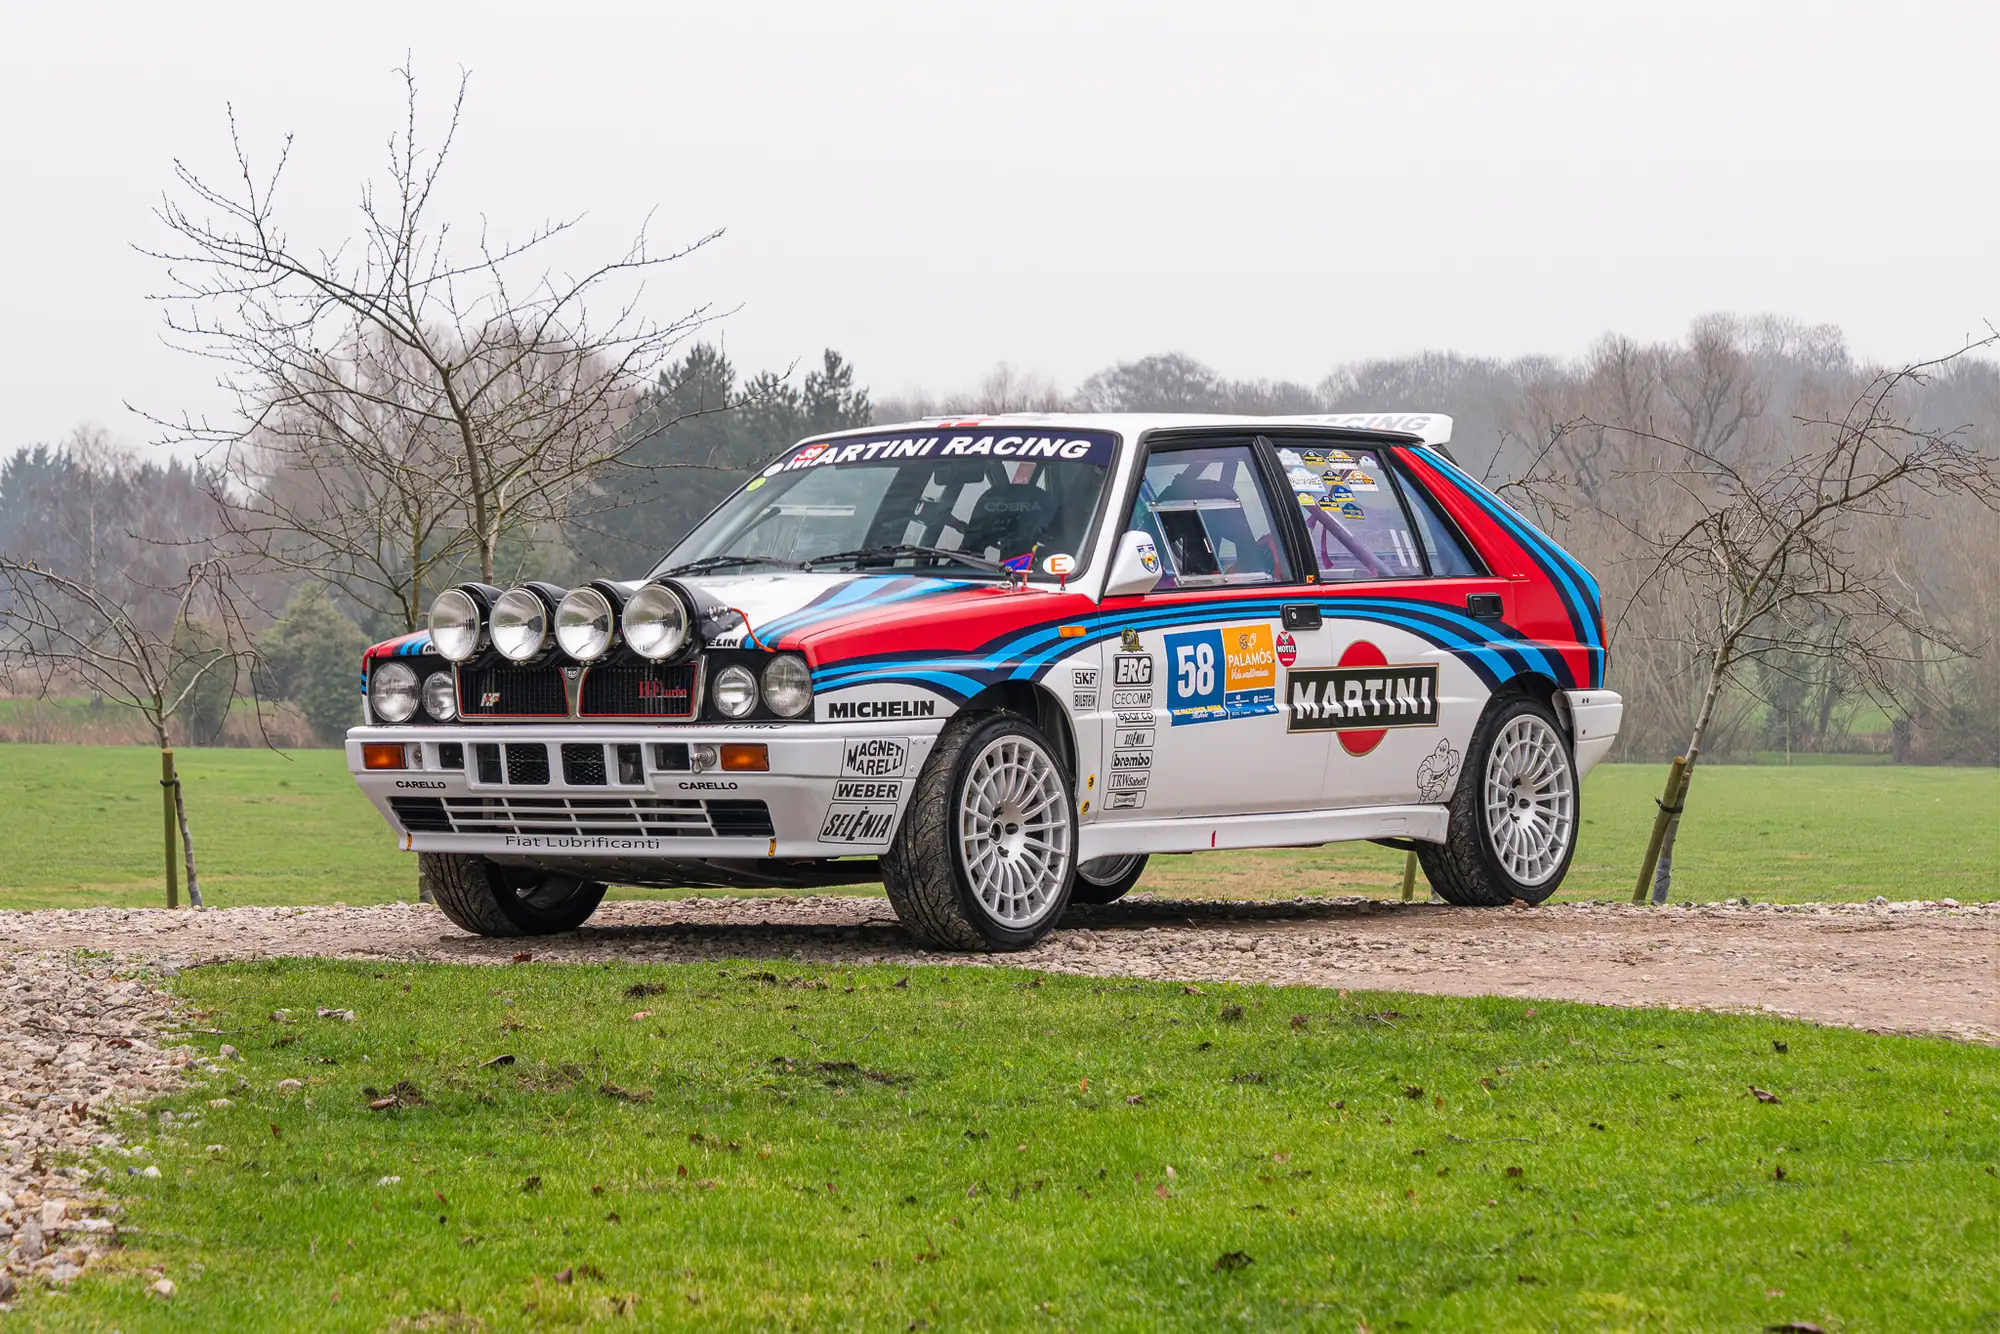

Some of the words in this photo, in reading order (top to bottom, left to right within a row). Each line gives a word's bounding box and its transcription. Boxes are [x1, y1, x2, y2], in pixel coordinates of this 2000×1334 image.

[941, 436, 1091, 459] RACING
[984, 501, 1042, 512] COBRA
[1051, 557, 1067, 572] E
[1277, 645, 1296, 653] MOTUL
[1116, 657, 1151, 683] ERG
[1176, 643, 1215, 698] 58
[1075, 672, 1096, 685] SKF
[1074, 694, 1096, 707] BILSTEIN
[1114, 693, 1151, 705] CECOMP
[1293, 677, 1432, 720] MARTINI
[828, 700, 935, 719] MICHELIN
[846, 740, 905, 768] MAGNETI
[1113, 752, 1150, 767] brembo
[395, 780, 446, 790] CARELLO
[678, 781, 738, 791] CARELLO
[837, 783, 898, 799] WEBER
[505, 835, 541, 847] Fiat
[545, 836, 660, 849] Lubrificanti
